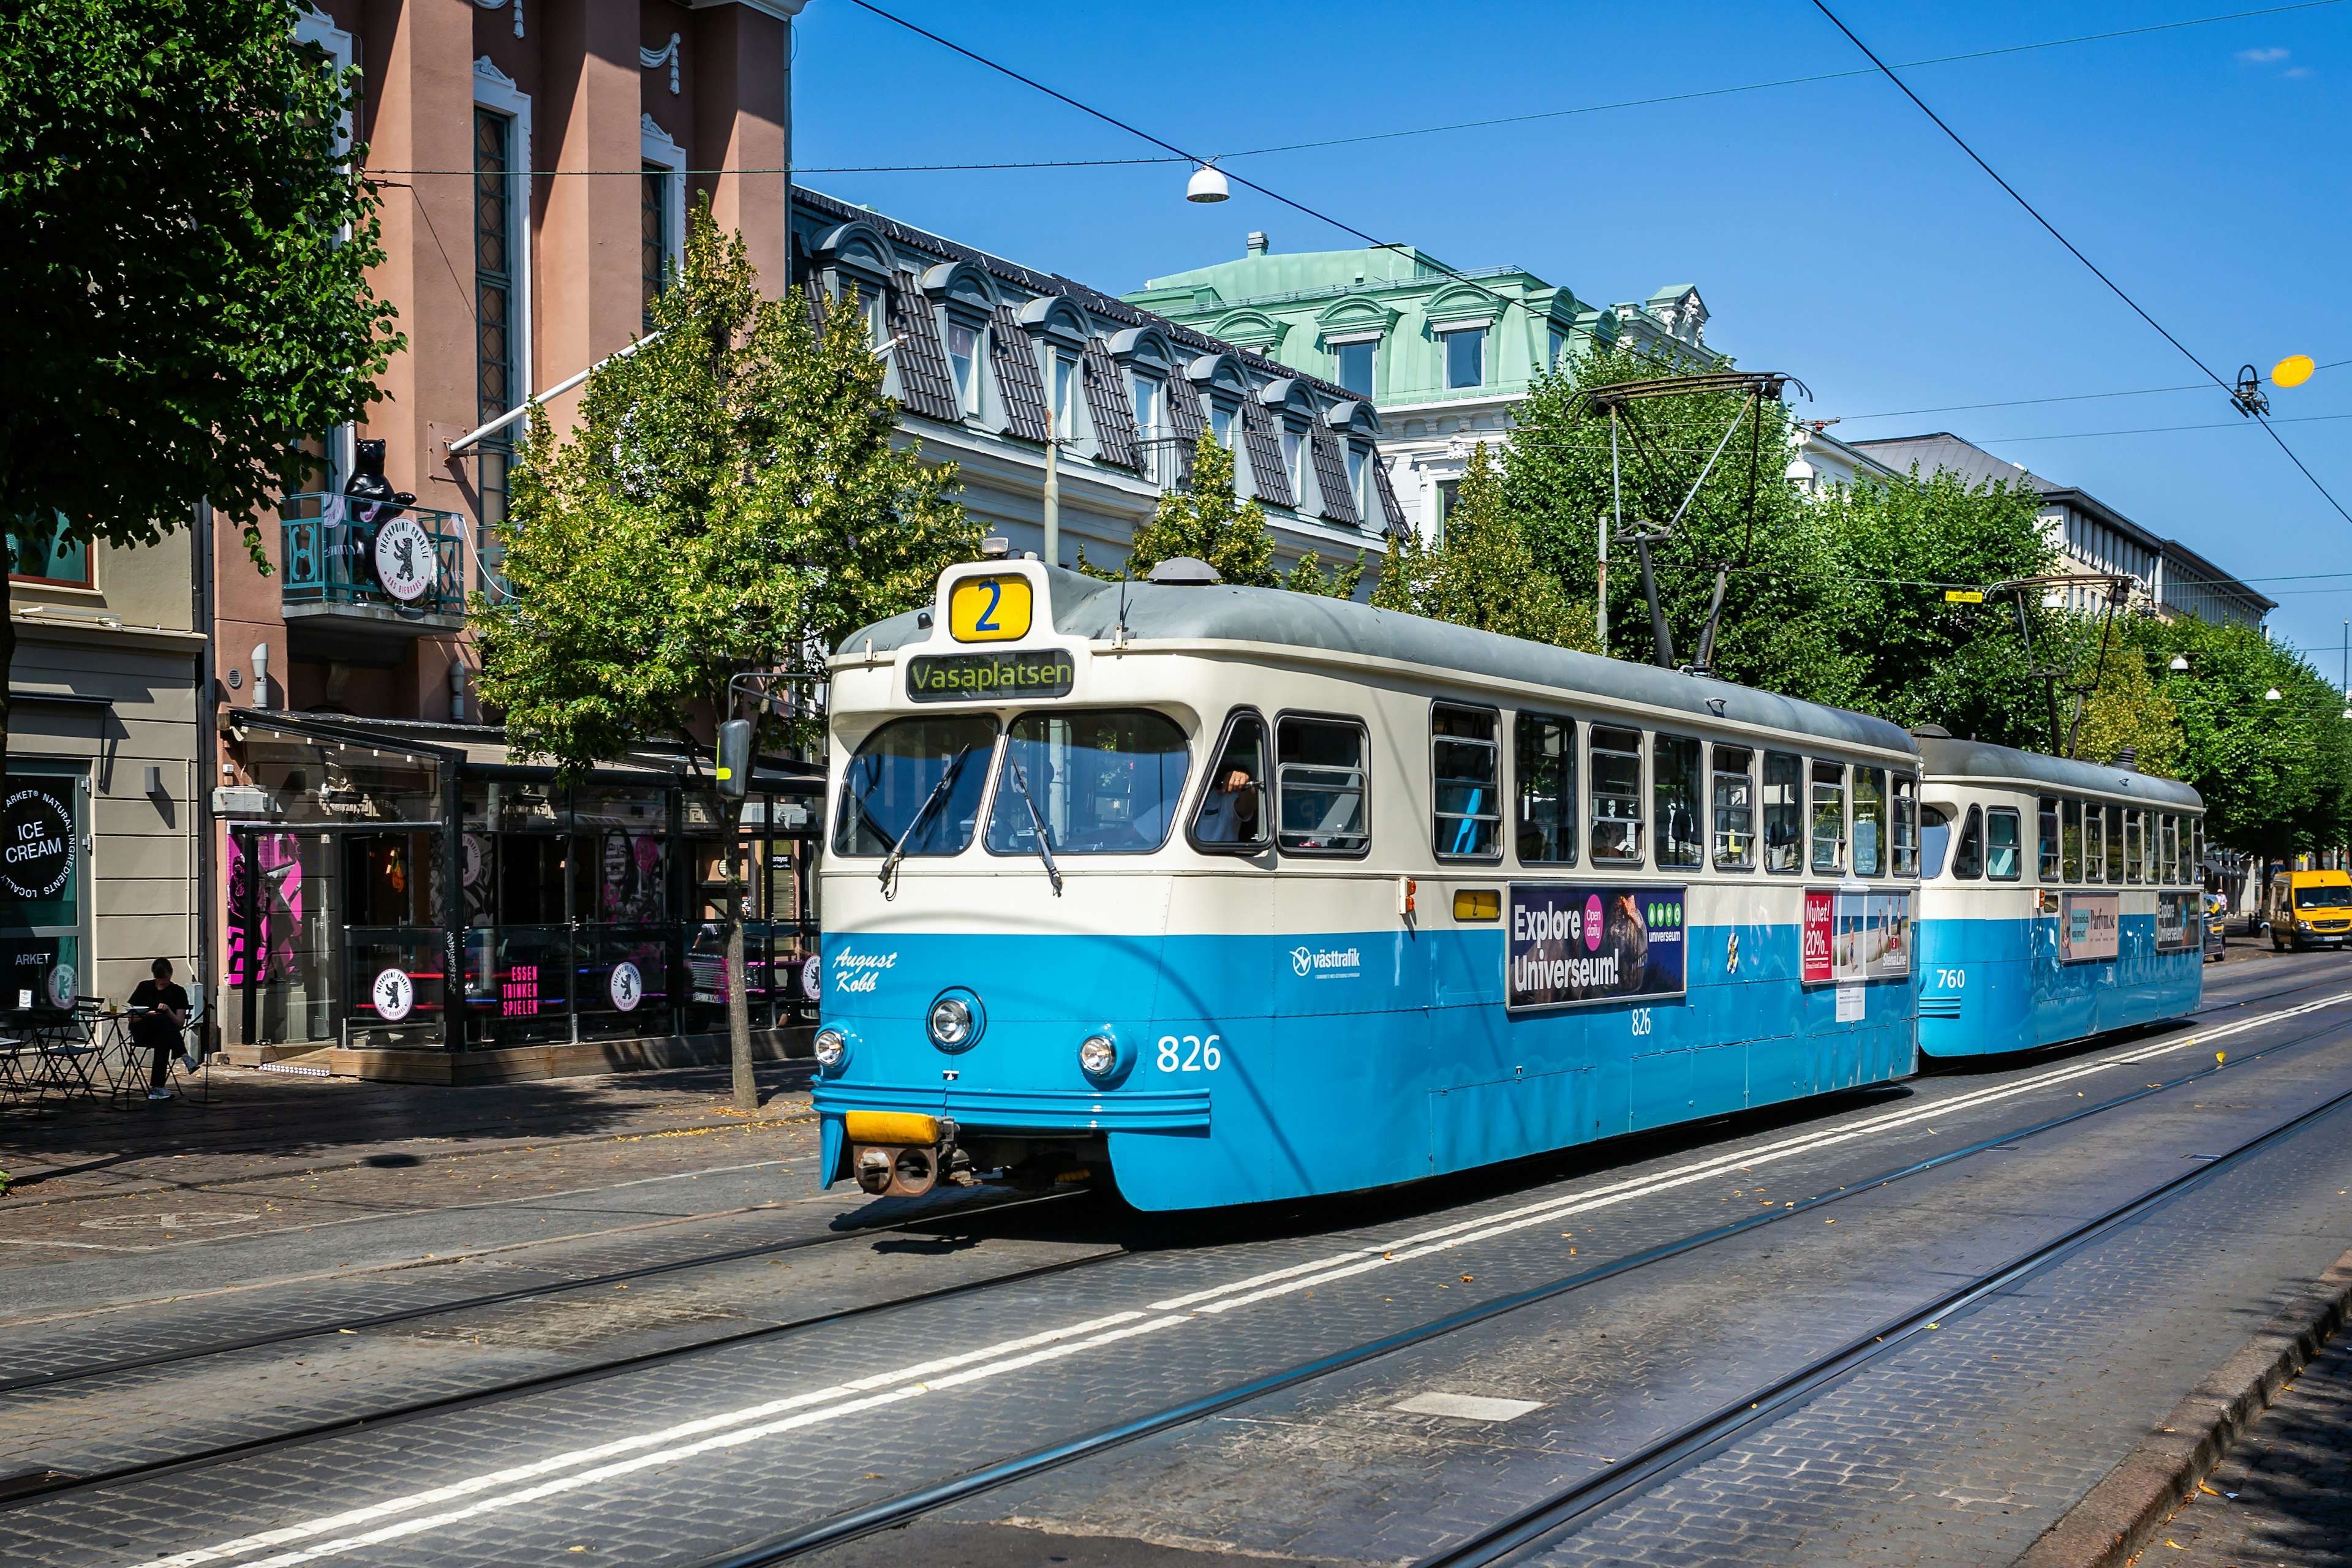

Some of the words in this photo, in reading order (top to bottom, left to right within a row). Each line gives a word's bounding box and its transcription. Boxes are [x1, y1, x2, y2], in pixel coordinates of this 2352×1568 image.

[380, 522, 409, 554] CHECKPOINT
[411, 527, 429, 559] CHARLIE
[387, 576, 397, 589] DAS
[398, 580, 421, 594] BIERHAUS
[976, 580, 1001, 631] 2
[912, 662, 1072, 692] Vasaplatsen
[42, 793, 73, 832] NATURAL
[18, 821, 45, 841] ICE
[6, 837, 62, 863] CREAM
[44, 834, 76, 895] INGREDIENTS
[1, 874, 37, 898] LOCALLY
[1472, 896, 1477, 916] 2
[1586, 909, 1601, 923] Open
[1806, 900, 1830, 929] Nyhet!
[1515, 901, 1581, 949] Explore
[1586, 925, 1600, 939] daily
[1649, 930, 1681, 943] universeum
[1805, 930, 1825, 956] 20%
[15, 953, 51, 965] ARKET
[832, 946, 898, 974] August
[1313, 948, 1360, 968] västtrafik
[1515, 948, 1619, 992] Universeum!
[511, 966, 537, 981] ESSEN
[836, 971, 879, 992] Kobb
[1937, 969, 1965, 989] 760
[503, 1000, 538, 1016] SPIELEN
[1632, 1007, 1651, 1036] 826
[1156, 1035, 1221, 1072] 826
